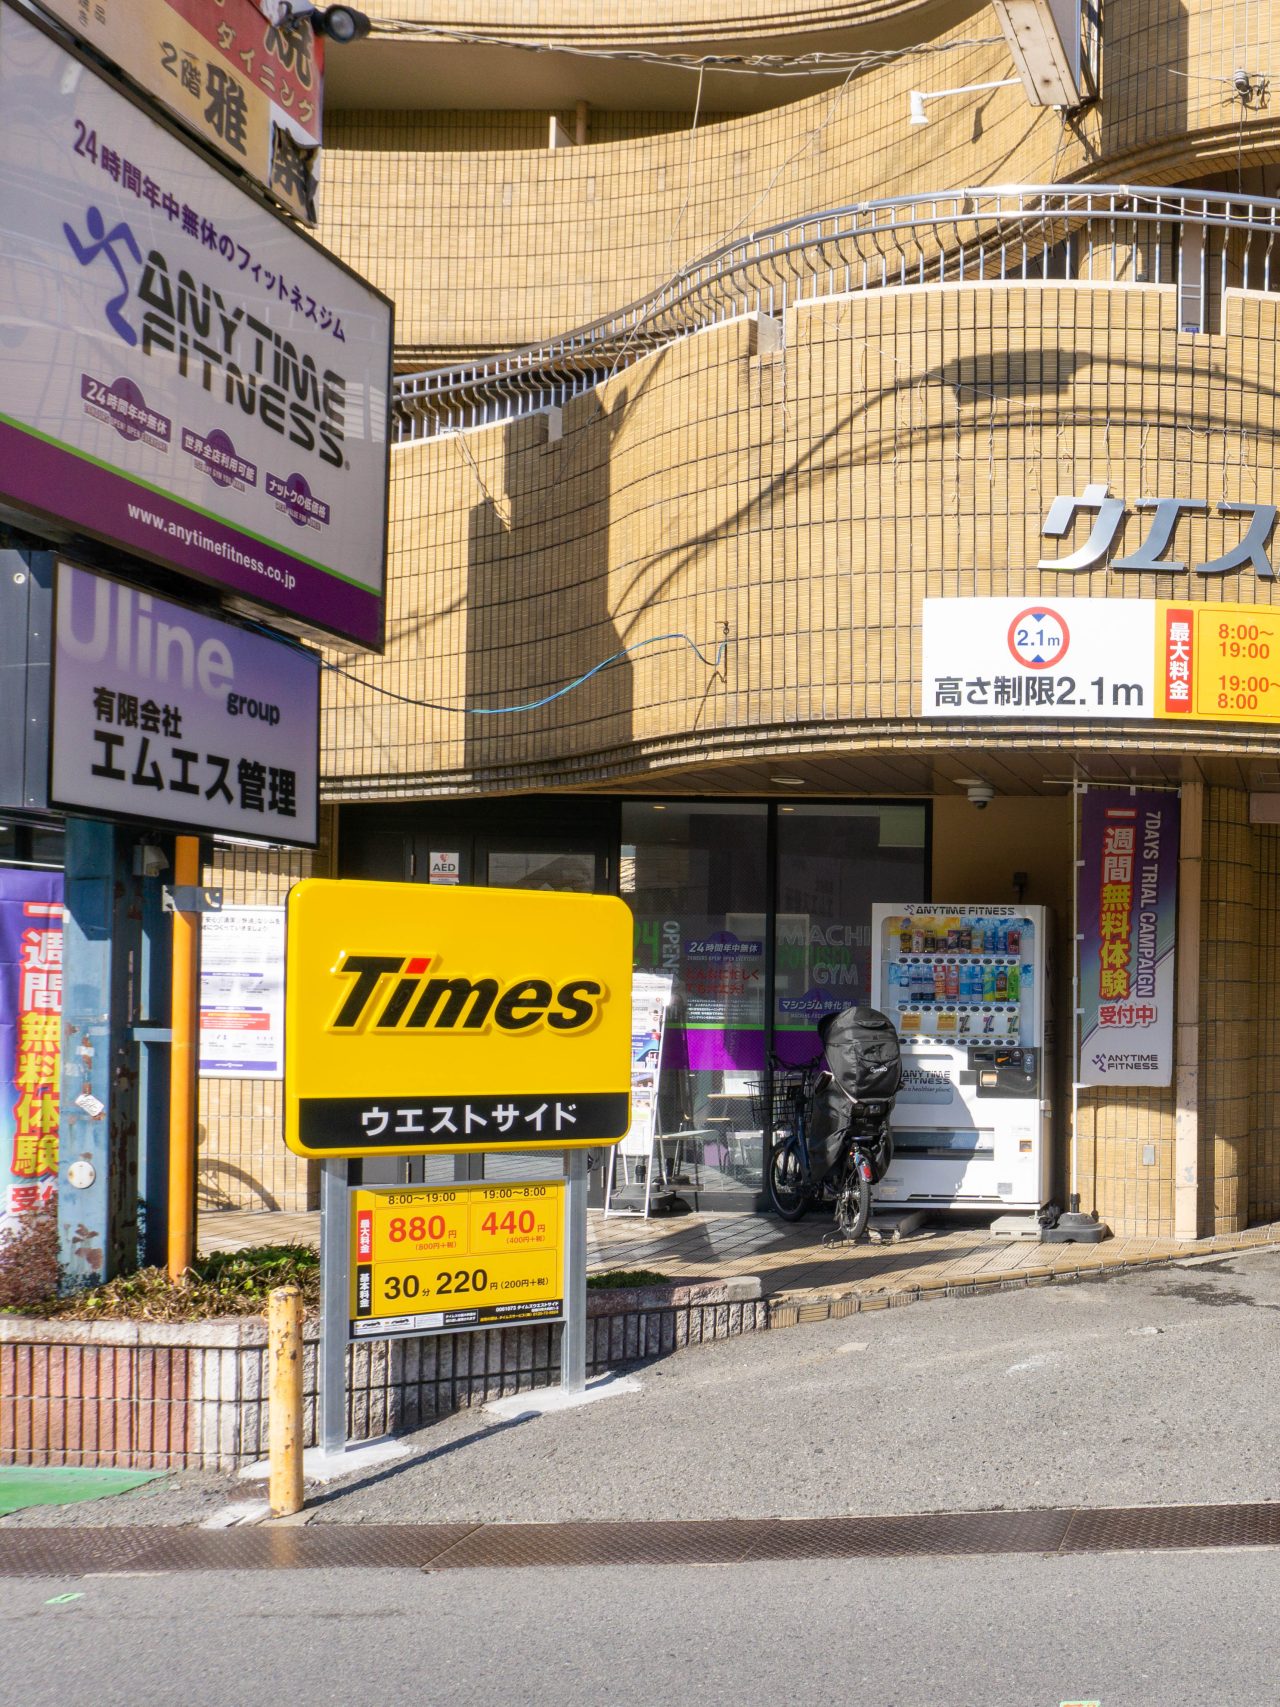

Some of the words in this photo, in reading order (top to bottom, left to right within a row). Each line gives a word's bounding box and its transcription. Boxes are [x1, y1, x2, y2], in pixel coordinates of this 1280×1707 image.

[73, 119, 346, 343] 24時間年中無休のフィットネスジム
[138, 250, 346, 430] ANYTIME
[86, 381, 168, 436] 24時間年中無休
[143, 312, 346, 470] FITNESS
[127, 503, 297, 590] www.anytimefitness.co.jp
[56, 566, 235, 699] Uline
[1016, 629, 1061, 647] 2.1m
[1219, 641, 1270, 660] 19:00
[1169, 622, 1190, 701] 最大料金
[92, 686, 183, 740] 有限会社
[226, 691, 281, 726] group
[934, 675, 1144, 708] 高さ制限2.1m
[1217, 693, 1258, 710] 8:00
[91, 729, 298, 818] エムエス管理
[1143, 811, 1161, 860] 7DAYS
[432, 862, 456, 872] AED
[1141, 862, 1160, 909] TRIAL
[915, 906, 966, 915] ANYTIME
[968, 906, 1015, 916] FITNESS
[1101, 810, 1135, 997] 一週間無料体験
[663, 920, 680, 968] OPEN
[689, 941, 759, 954] 24時間年中無休
[1136, 910, 1157, 998] CAMPAIGN
[332, 955, 602, 1031] Times
[812, 962, 859, 985] GYM
[1100, 1004, 1154, 1025] 受付中
[902, 1069, 950, 1079] ANYTIME
[1107, 1054, 1158, 1062] ANYTIME
[1107, 1062, 1158, 1071] FITNESS
[361, 1101, 577, 1136] ウエストサイド
